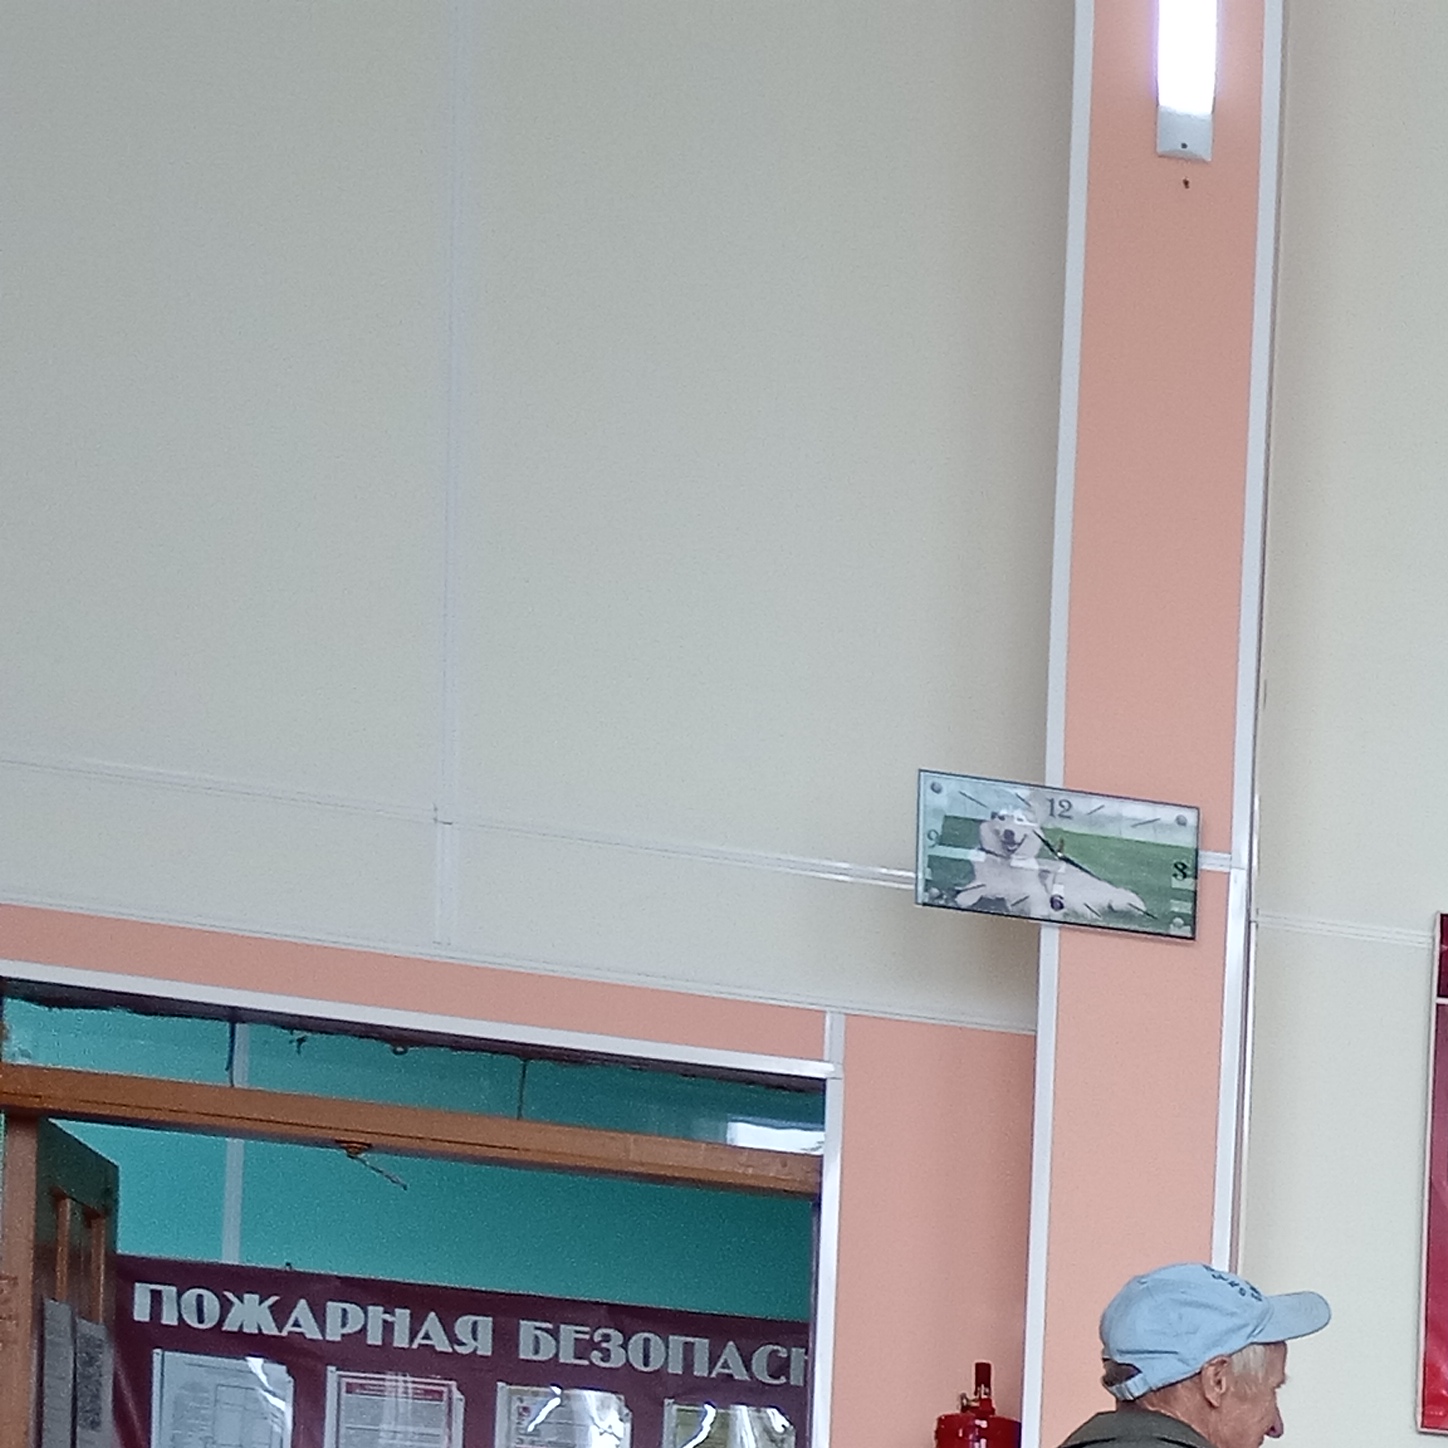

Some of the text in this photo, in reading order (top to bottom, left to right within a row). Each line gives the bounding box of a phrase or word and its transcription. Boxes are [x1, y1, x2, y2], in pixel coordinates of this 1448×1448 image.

[1047, 798, 1073, 819] 12
[1050, 894, 1064, 911] 6
[133, 1282, 493, 1356] ПОЖАРНАЯ
